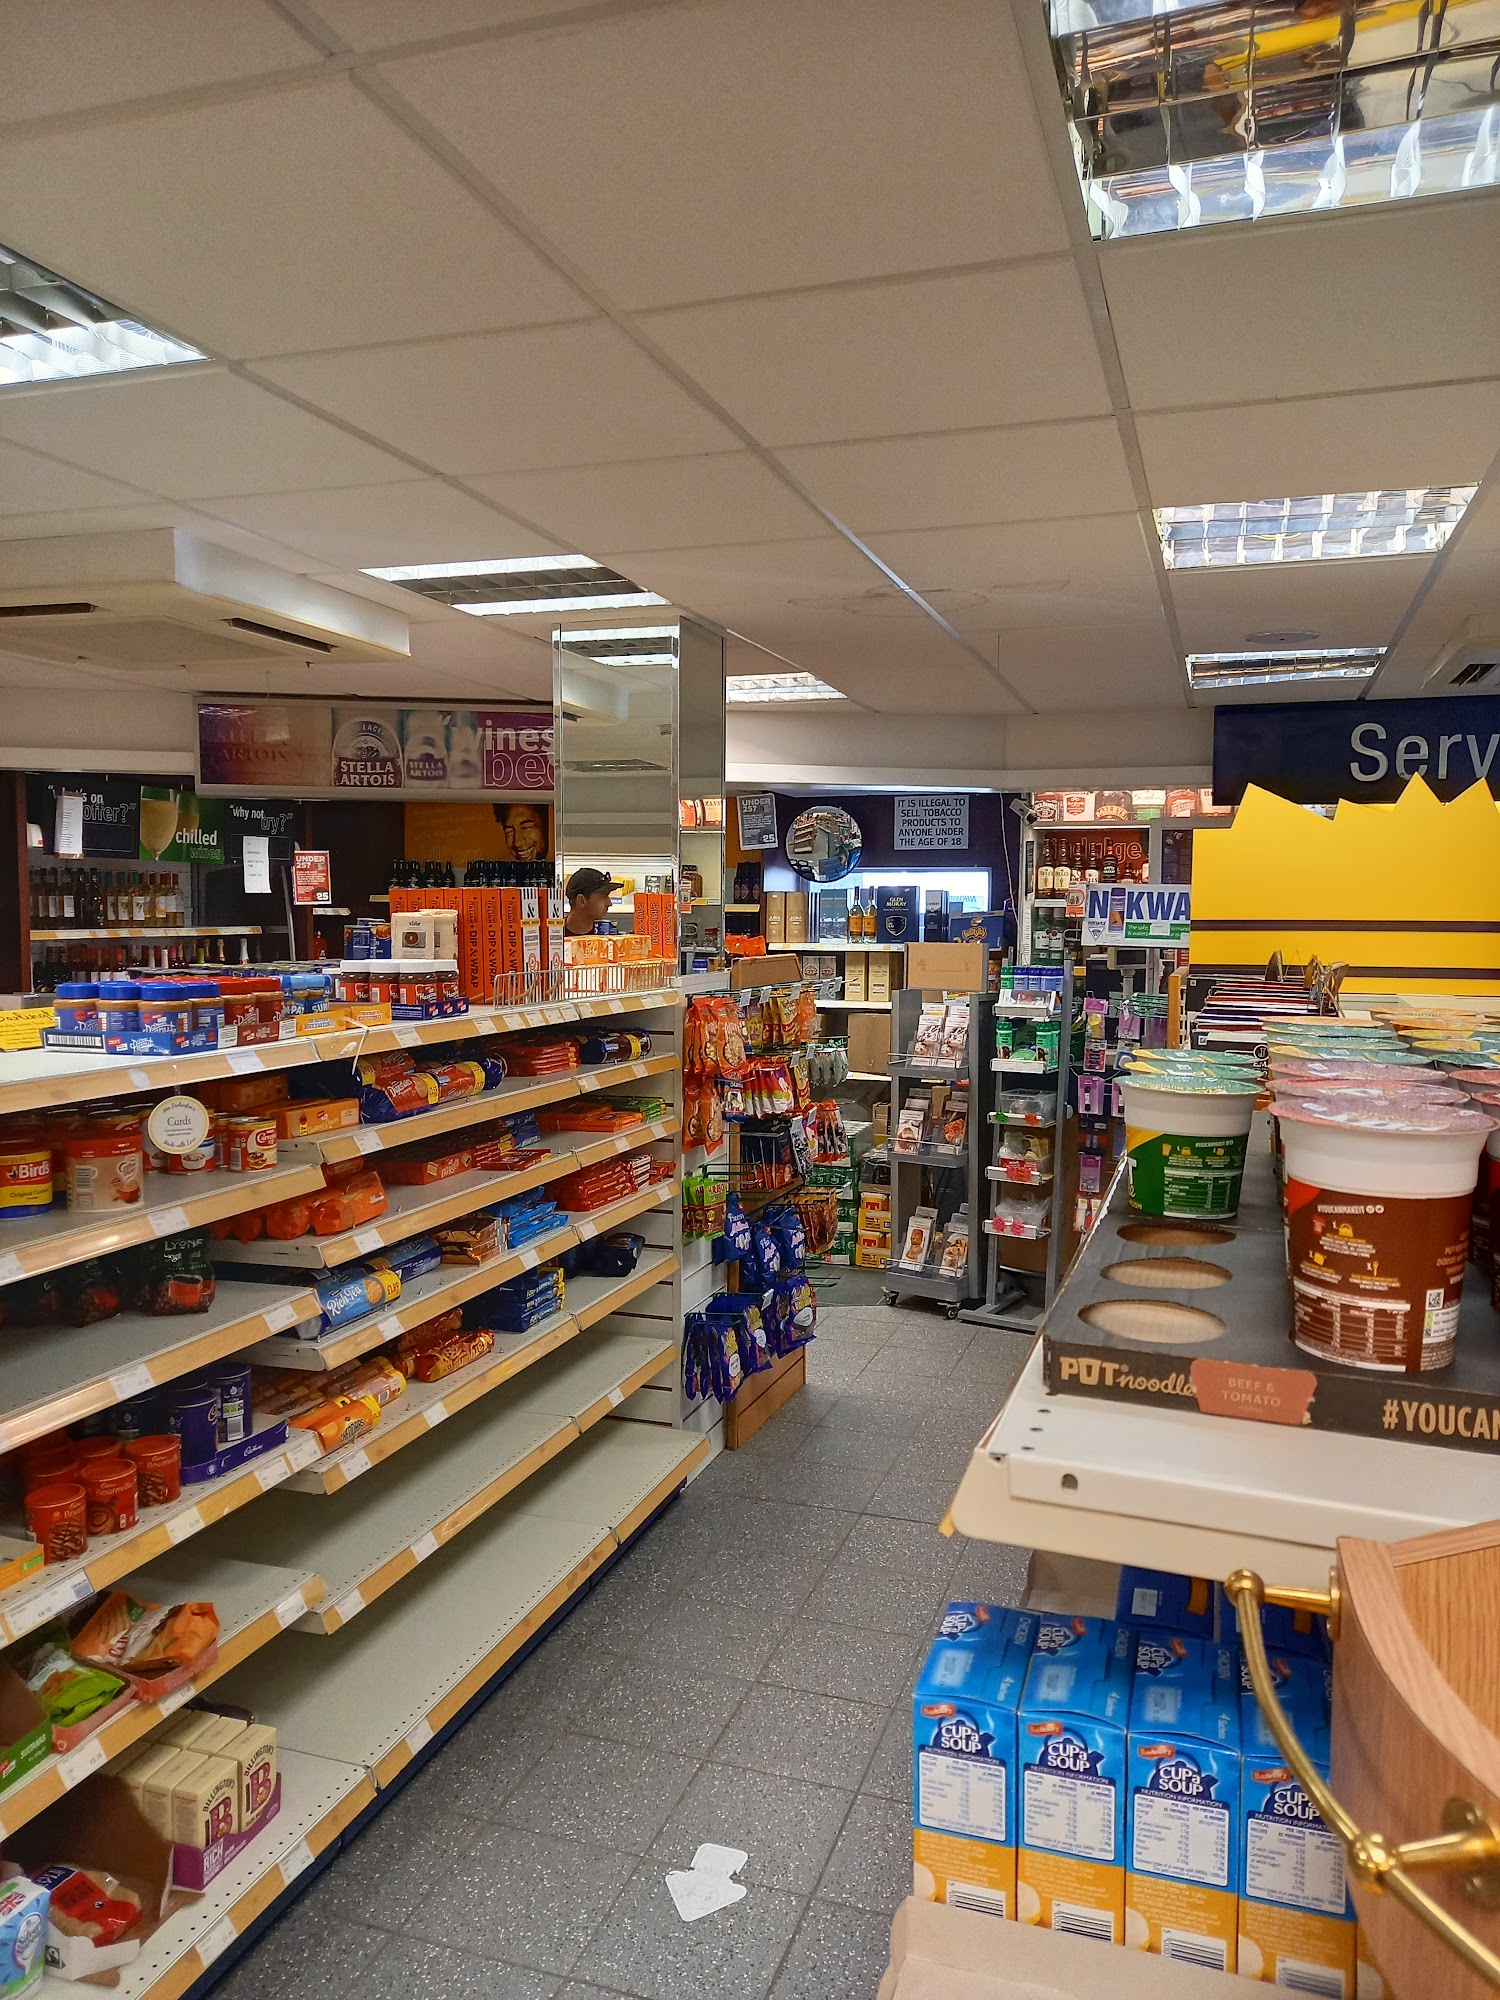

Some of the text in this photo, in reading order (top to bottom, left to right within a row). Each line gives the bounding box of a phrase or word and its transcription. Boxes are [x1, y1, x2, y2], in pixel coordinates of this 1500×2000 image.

[340, 760, 394, 773] STELLA
[409, 760, 443, 769] STELLA
[341, 773, 395, 787] ARTOIS
[410, 768, 443, 777] ARTOIS
[742, 798, 770, 806] UNDER
[742, 805, 757, 813] 25?
[898, 798, 965, 808] IT IS ILLEGAL TO
[251, 807, 264, 819] not
[901, 808, 961, 817] SELL TOBACCO
[1096, 805, 1128, 819] BAILEYS
[902, 817, 961, 827] PRODUCTS TO
[175, 828, 217, 846] chilled
[762, 834, 775, 843] 25
[899, 827, 964, 837] ANYONE UNDER
[900, 837, 961, 846] THE AGE OF 18
[190, 846, 222, 860] wines
[316, 892, 329, 900] 25
[526, 904, 535, 918] &
[552, 903, 560, 918] &
[470, 931, 478, 947] DIP
[488, 931, 496, 947] DIP
[508, 931, 516, 947] DIP
[470, 958, 478, 988] WRAP
[490, 958, 498, 988] WRAP
[167, 1115, 192, 1126] Curds
[19, 1160, 50, 1179] Bird's
[10, 1190, 33, 1199] Original
[708, 1183, 725, 1195] HARIBO
[327, 1285, 363, 1317] Rich Tea
[1060, 1356, 1119, 1387] POT
[1228, 1378, 1276, 1393] BEEF &
[1222, 1390, 1281, 1407] TOMATO
[244, 1444, 263, 1457] Cadbury
[942, 1724, 979, 1742] CUP a
[941, 1737, 981, 1754] SOUP
[1048, 1743, 1087, 1761] CUP a
[243, 1744, 275, 1777] BILLINGTON'S
[1047, 1755, 1091, 1773] SOUP
[1030, 1765, 1109, 1784] NUTRITION INFORMATION
[1159, 1765, 1200, 1784] CUP a
[202, 1778, 234, 1811] BILLINGTON'S
[1159, 1778, 1203, 1796] SOUP
[1141, 1788, 1222, 1808] NUTRITION INFORMATION
[1274, 1791, 1309, 1806] CUP
[1273, 1803, 1320, 1821] SOUP
[1255, 1813, 1327, 1831] NUTRITION INFORMAT
[203, 1838, 224, 1870] RICH
